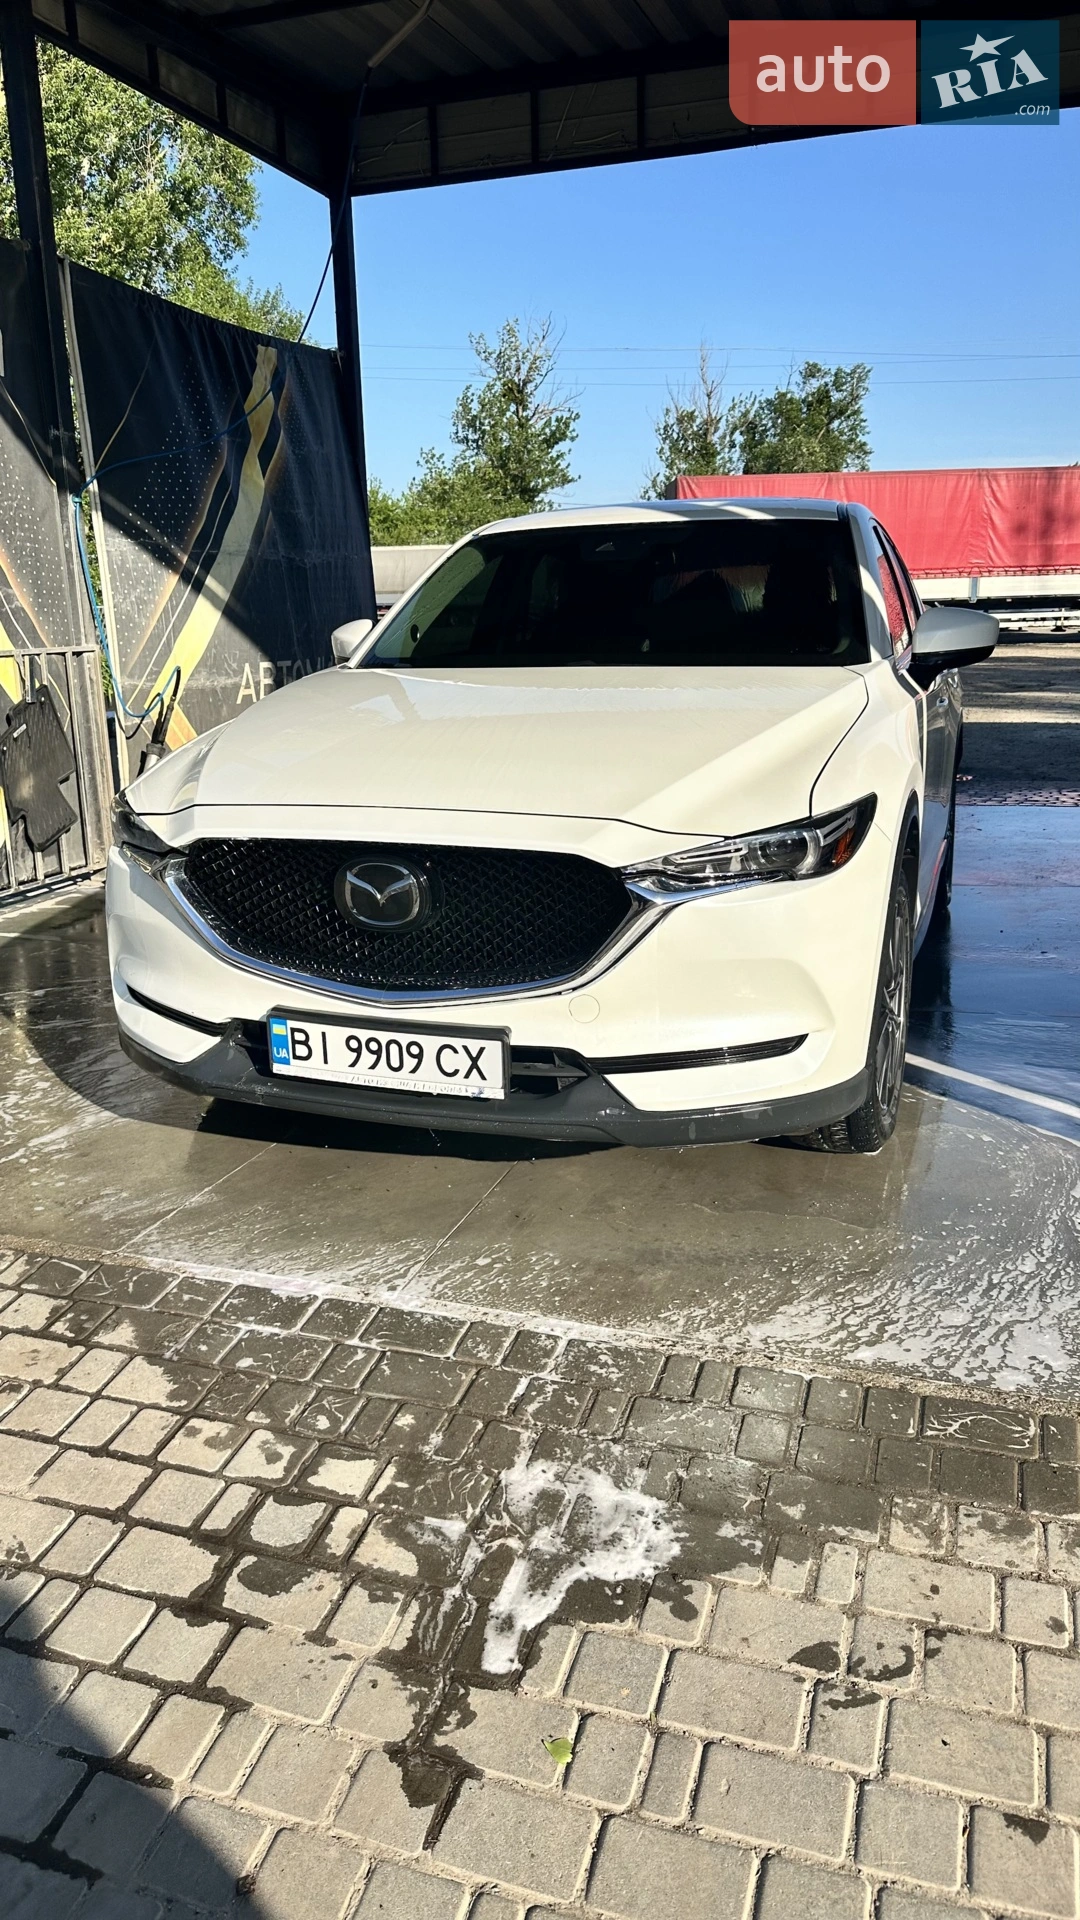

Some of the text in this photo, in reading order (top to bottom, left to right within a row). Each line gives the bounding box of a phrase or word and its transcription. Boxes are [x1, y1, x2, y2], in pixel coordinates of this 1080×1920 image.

[273, 1046, 289, 1060] UA
[290, 1026, 488, 1081] BI 9909 CX
